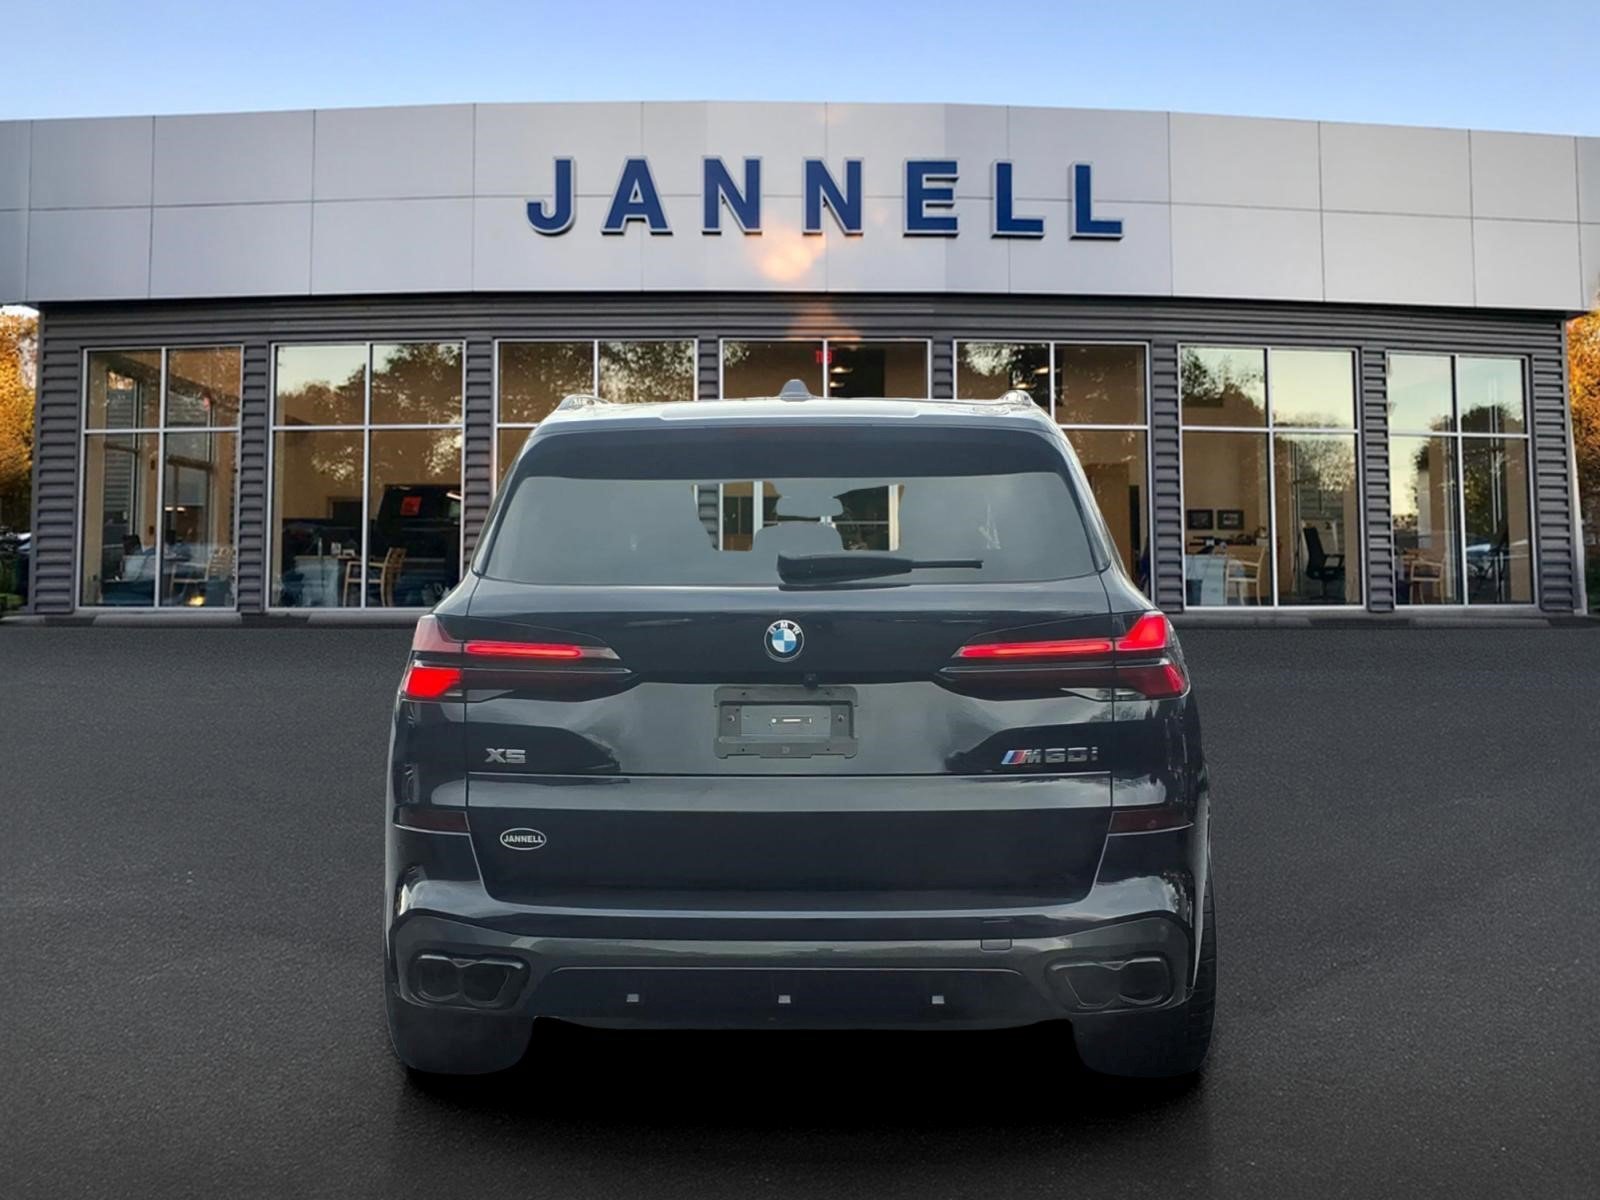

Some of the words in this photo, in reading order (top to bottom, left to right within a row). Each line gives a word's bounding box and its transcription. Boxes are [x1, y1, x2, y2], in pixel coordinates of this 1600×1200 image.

[526, 155, 1124, 240] JANNELL
[768, 621, 801, 635] BMW
[485, 747, 526, 764] X5
[503, 834, 544, 843] JANNELL
